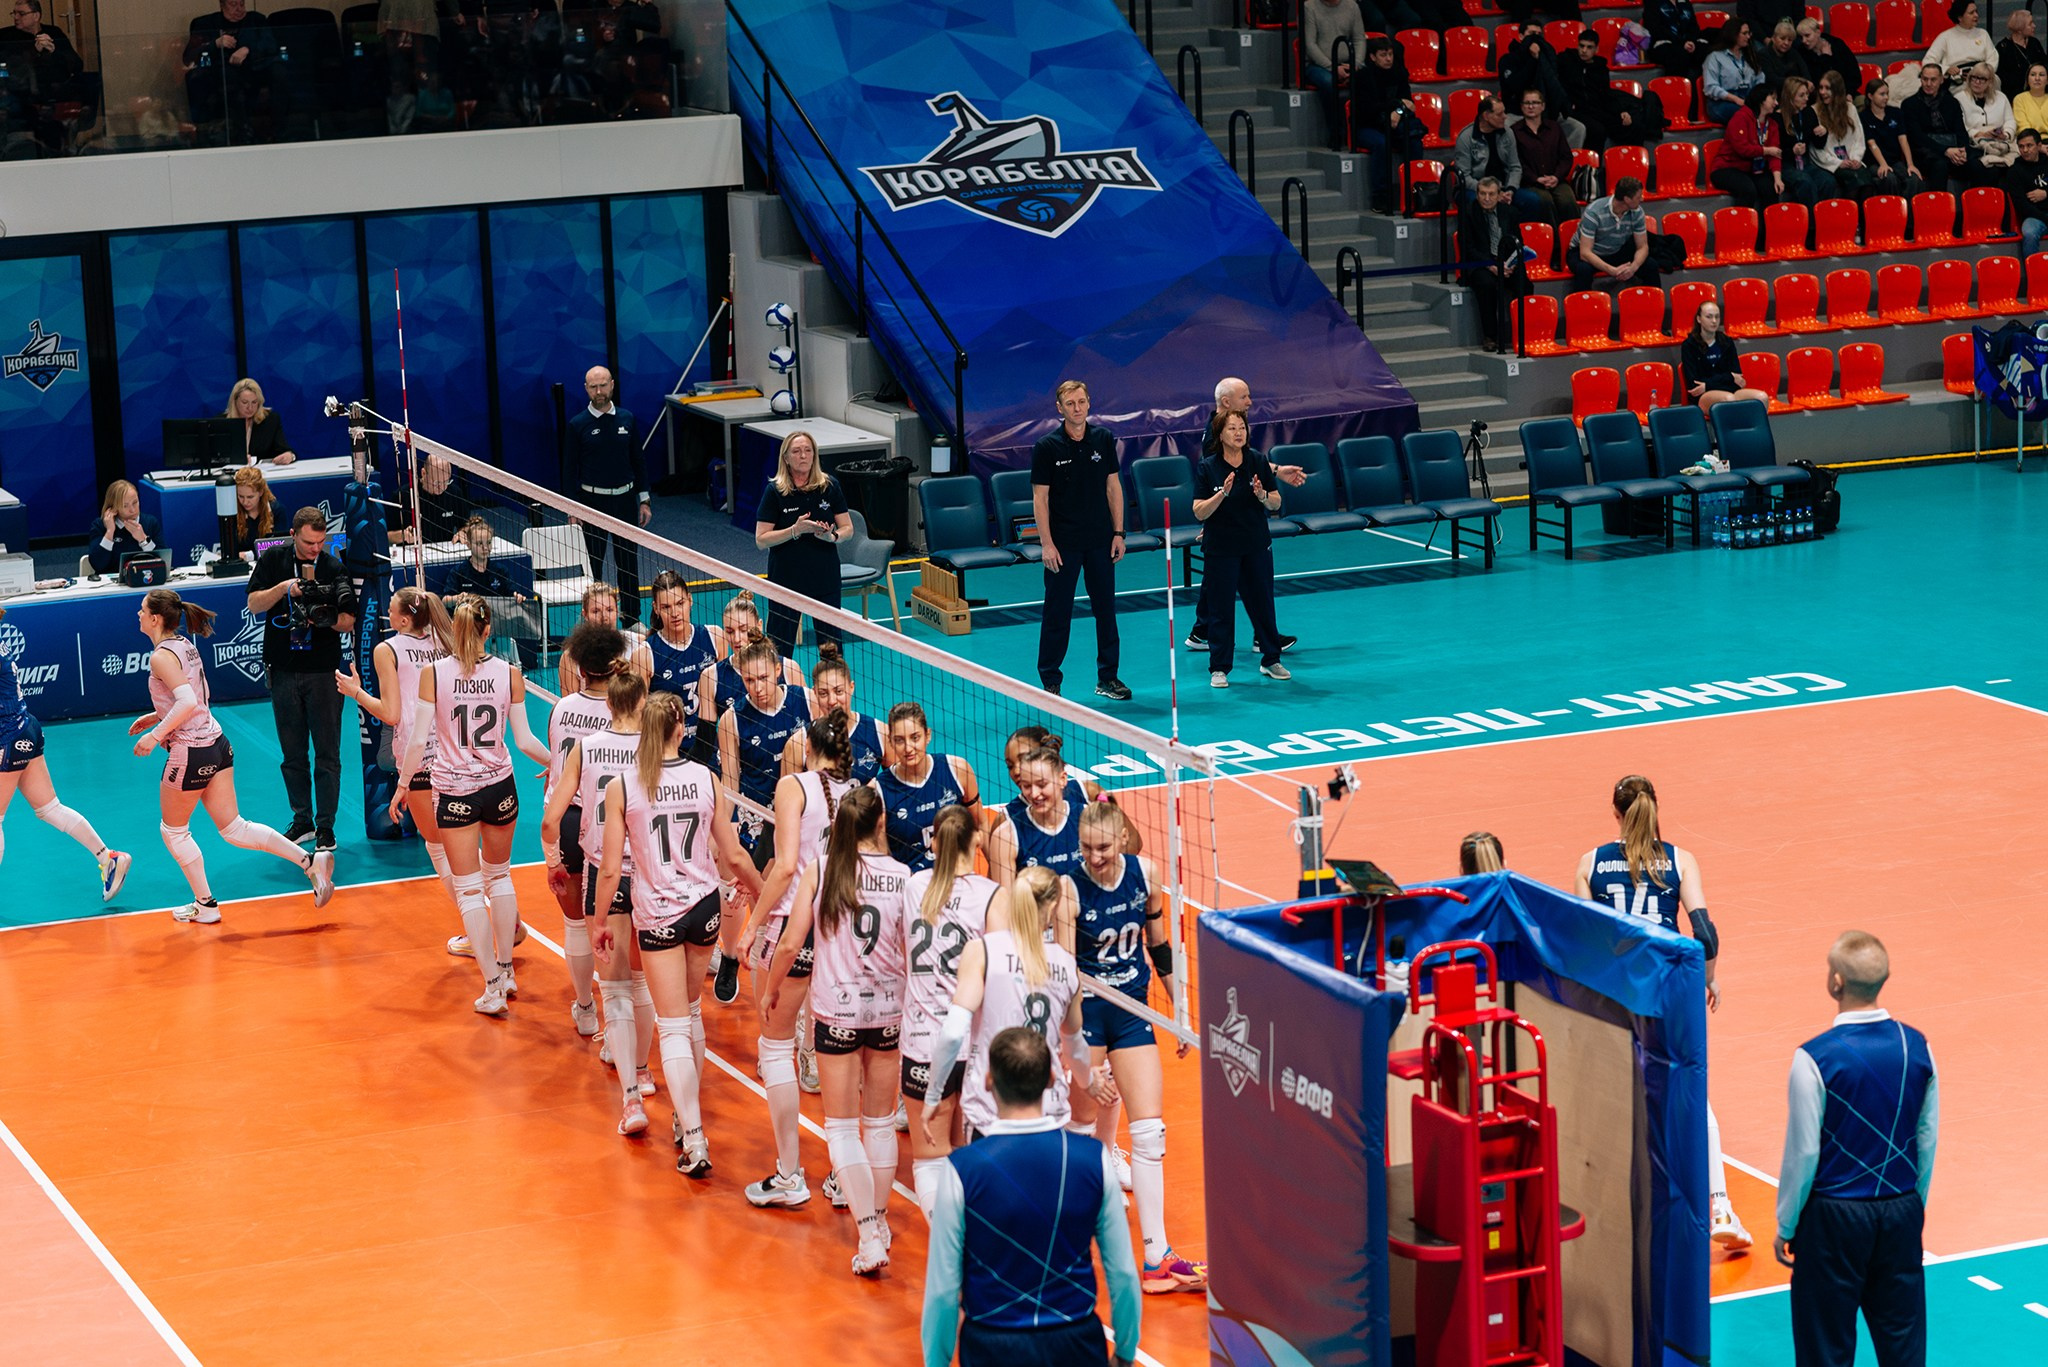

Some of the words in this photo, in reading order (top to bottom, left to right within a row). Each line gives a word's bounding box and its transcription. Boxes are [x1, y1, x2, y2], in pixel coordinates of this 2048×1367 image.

[882, 155, 1143, 201] КОРАБЕЛКА
[1344, 161, 1350, 170] 5
[959, 182, 1085, 200] САНКТ-ПЕТЕРБУРГ
[1399, 227, 1406, 236] 4
[1453, 293, 1460, 303] 3
[7, 353, 76, 374] КОРАБЕЛКА
[1510, 364, 1517, 374] 2
[917, 603, 941, 626] DARPOL
[218, 642, 264, 662] КОРАБЕ
[360, 597, 381, 727] СКТ-ПЕТЕРБУРГ
[406, 649, 448, 663] ТУРЧИН
[453, 678, 496, 694] ЛОЗЮК
[683, 681, 699, 716] 3
[451, 704, 498, 750] 12
[649, 811, 700, 866] 17
[1606, 882, 1663, 924] 14
[851, 904, 881, 959] 9
[1097, 921, 1141, 963] 20
[909, 918, 968, 977] 22
[1295, 1074, 1333, 1119] ВФВ
